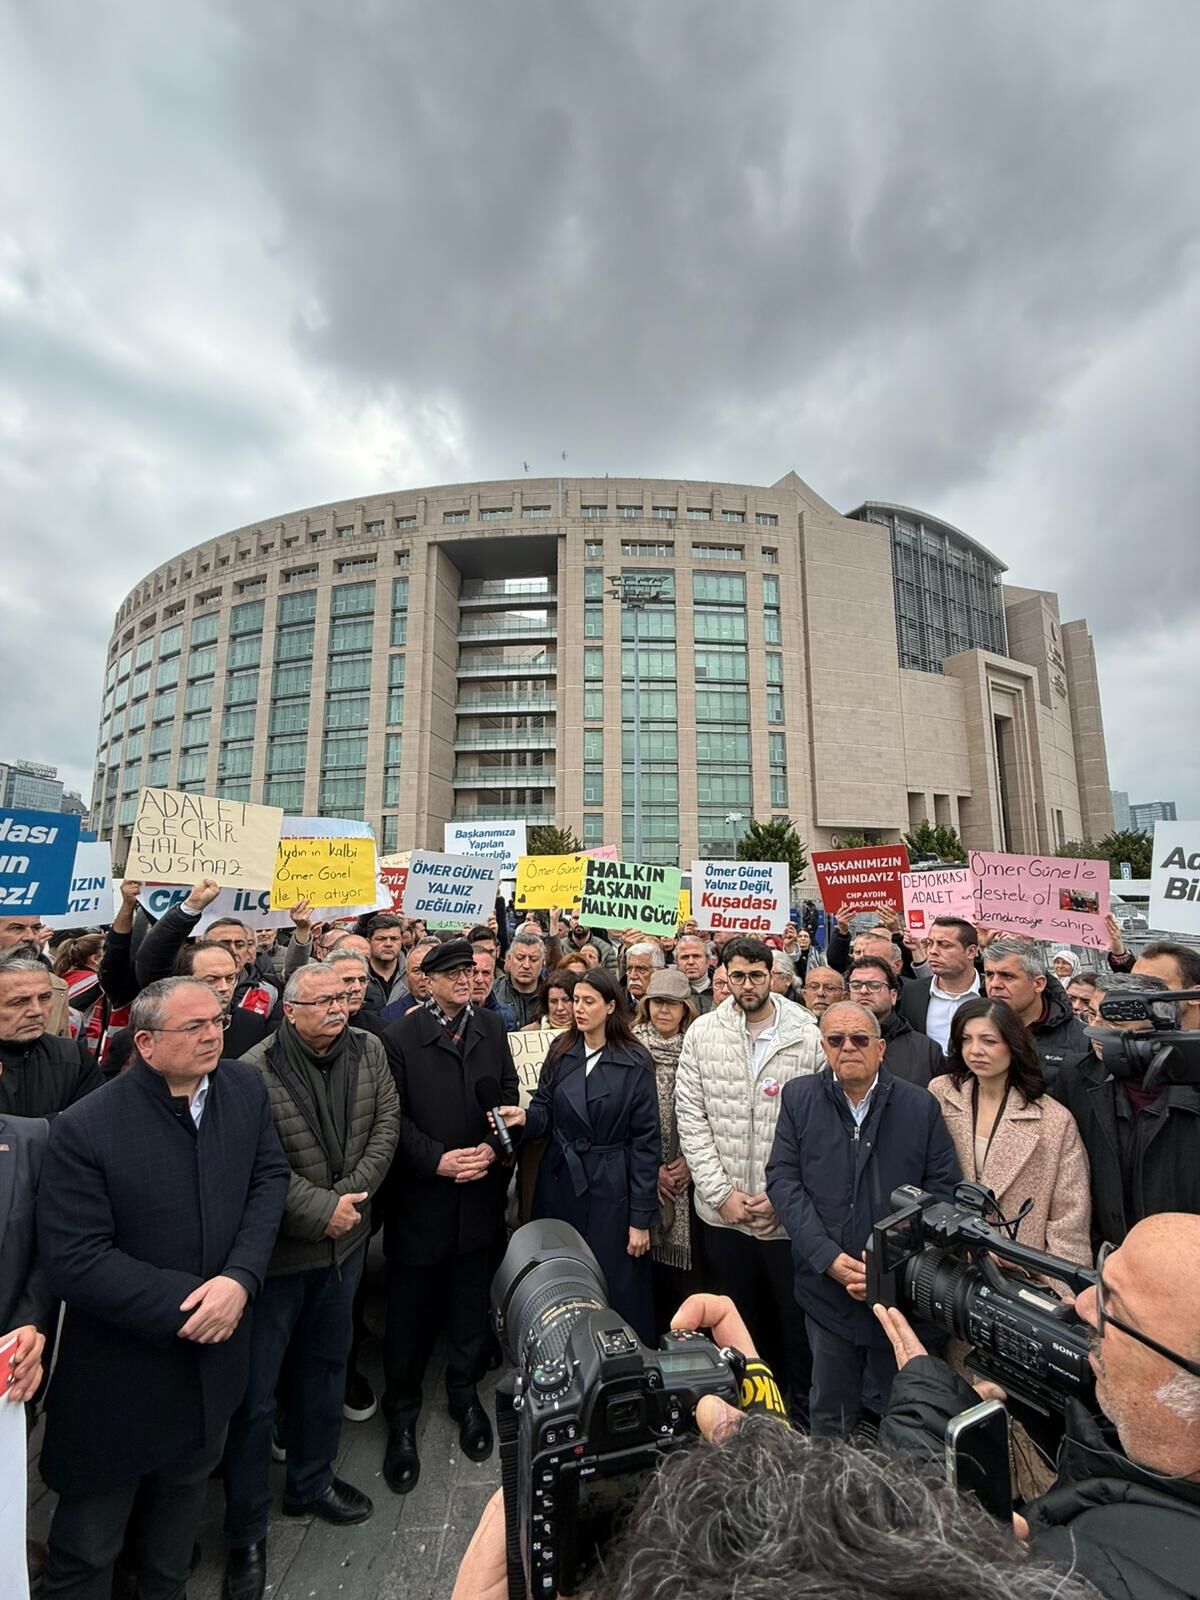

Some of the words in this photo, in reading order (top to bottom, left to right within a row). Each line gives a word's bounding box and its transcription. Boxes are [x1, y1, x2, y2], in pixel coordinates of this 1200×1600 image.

[141, 790, 253, 826] ADALET
[455, 829, 516, 840] Başkanımıza
[137, 836, 205, 857] HALK
[469, 840, 504, 851] Yapılan
[412, 860, 452, 876] ÖMER
[452, 865, 495, 881] GÜNEL
[526, 859, 555, 878] Ömer
[587, 860, 665, 883] HALKIN
[705, 863, 737, 877] Ömer
[738, 866, 773, 878] Günel
[817, 856, 902, 873] BAŞKANIMIZIN
[971, 851, 1026, 877] Ömer
[1029, 859, 1097, 879] Günel'e
[704, 879, 738, 891] Yalnız
[739, 880, 774, 894] Değil,
[825, 871, 894, 885] YANINDAYIZ
[428, 881, 473, 896] YALNIZ
[584, 878, 651, 900] BAŞKANI
[862, 890, 887, 898] AYDIN
[911, 890, 954, 903] ADALET
[972, 879, 1029, 902] destek
[1033, 883, 1051, 906] ol
[415, 898, 476, 914] DEĞİLDİR
[701, 892, 778, 912] Kuşadası
[581, 897, 637, 920] HALKIN
[640, 905, 679, 925] GÜCÜ
[710, 913, 771, 930] Burada
[1052, 1342, 1081, 1360] SONY
